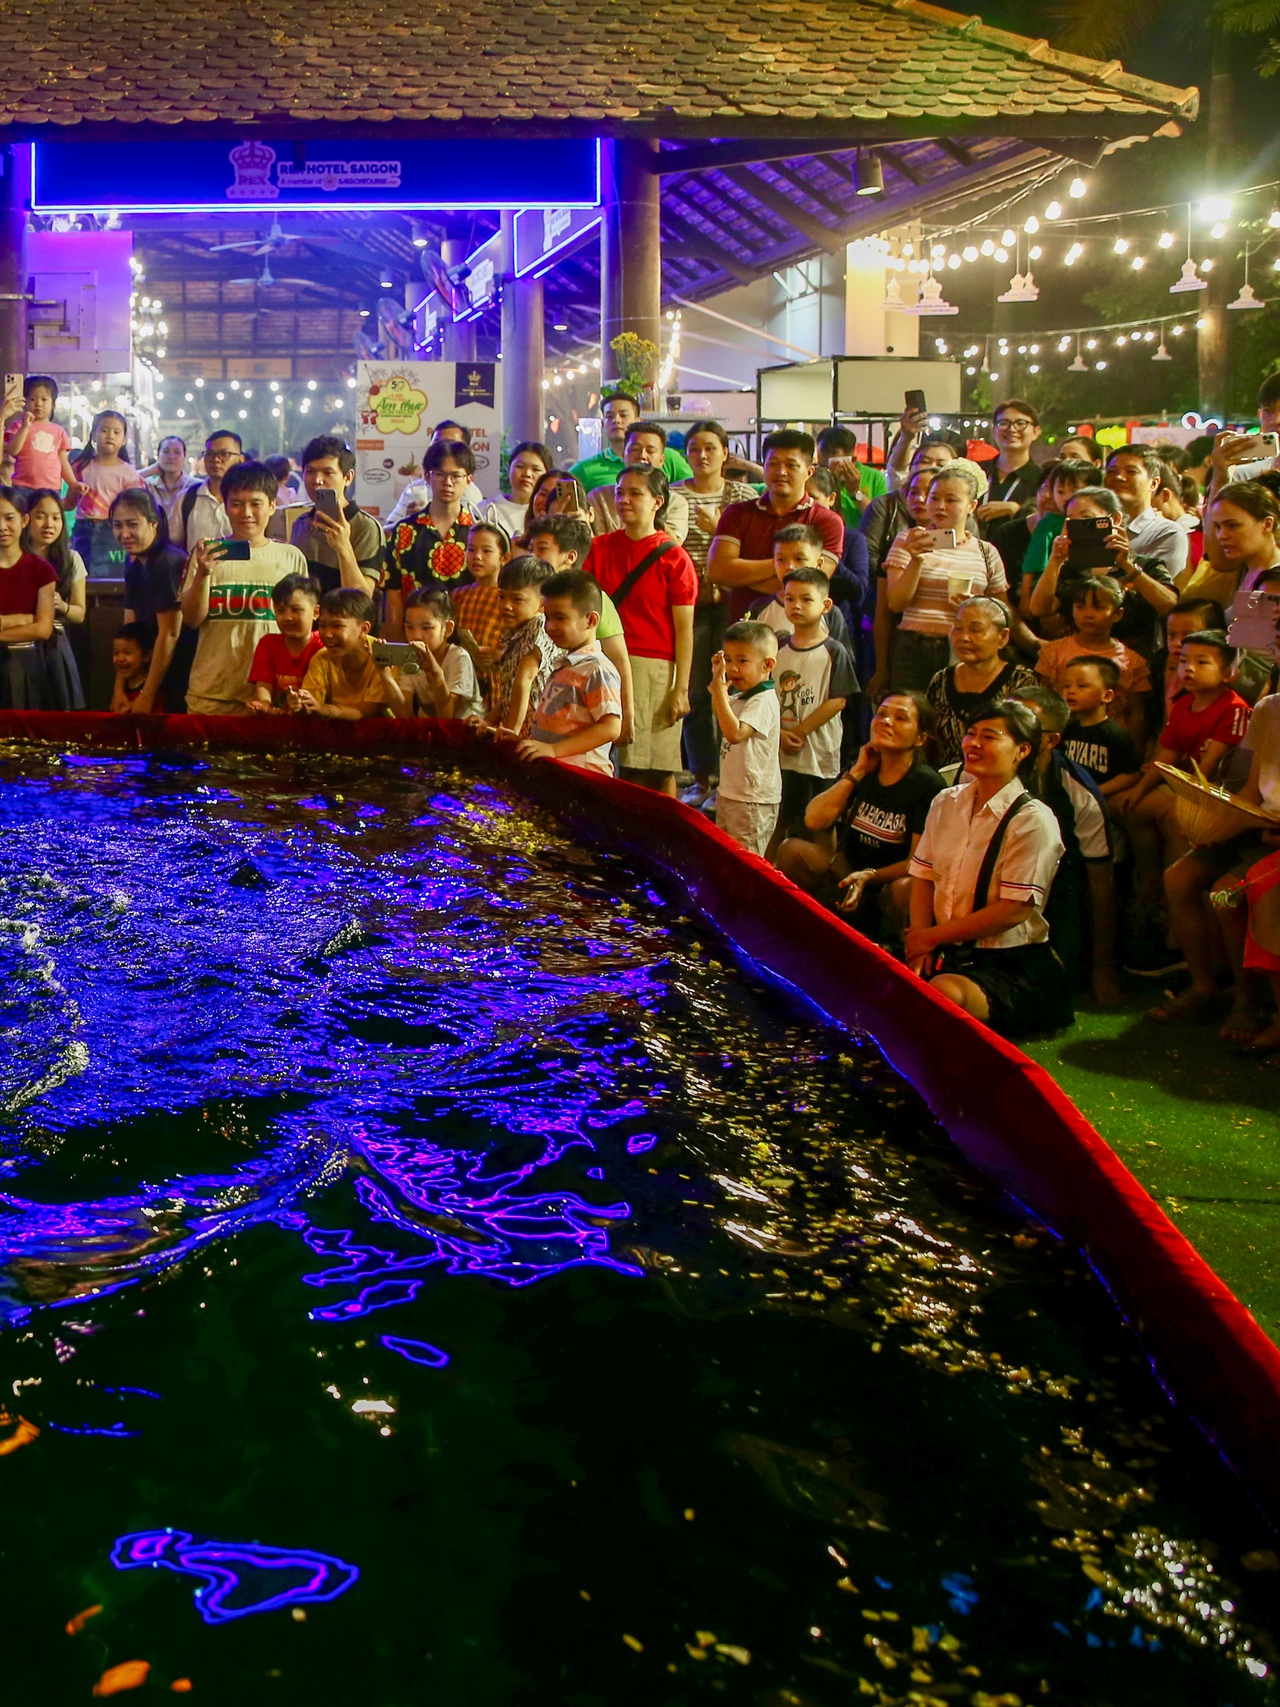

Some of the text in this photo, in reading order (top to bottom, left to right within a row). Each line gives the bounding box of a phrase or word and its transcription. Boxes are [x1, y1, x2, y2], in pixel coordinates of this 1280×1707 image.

[280, 164, 398, 174] RE HOTEL SAIGON
[801, 695, 815, 706] BOY
[1065, 740, 1108, 774] RVARD
